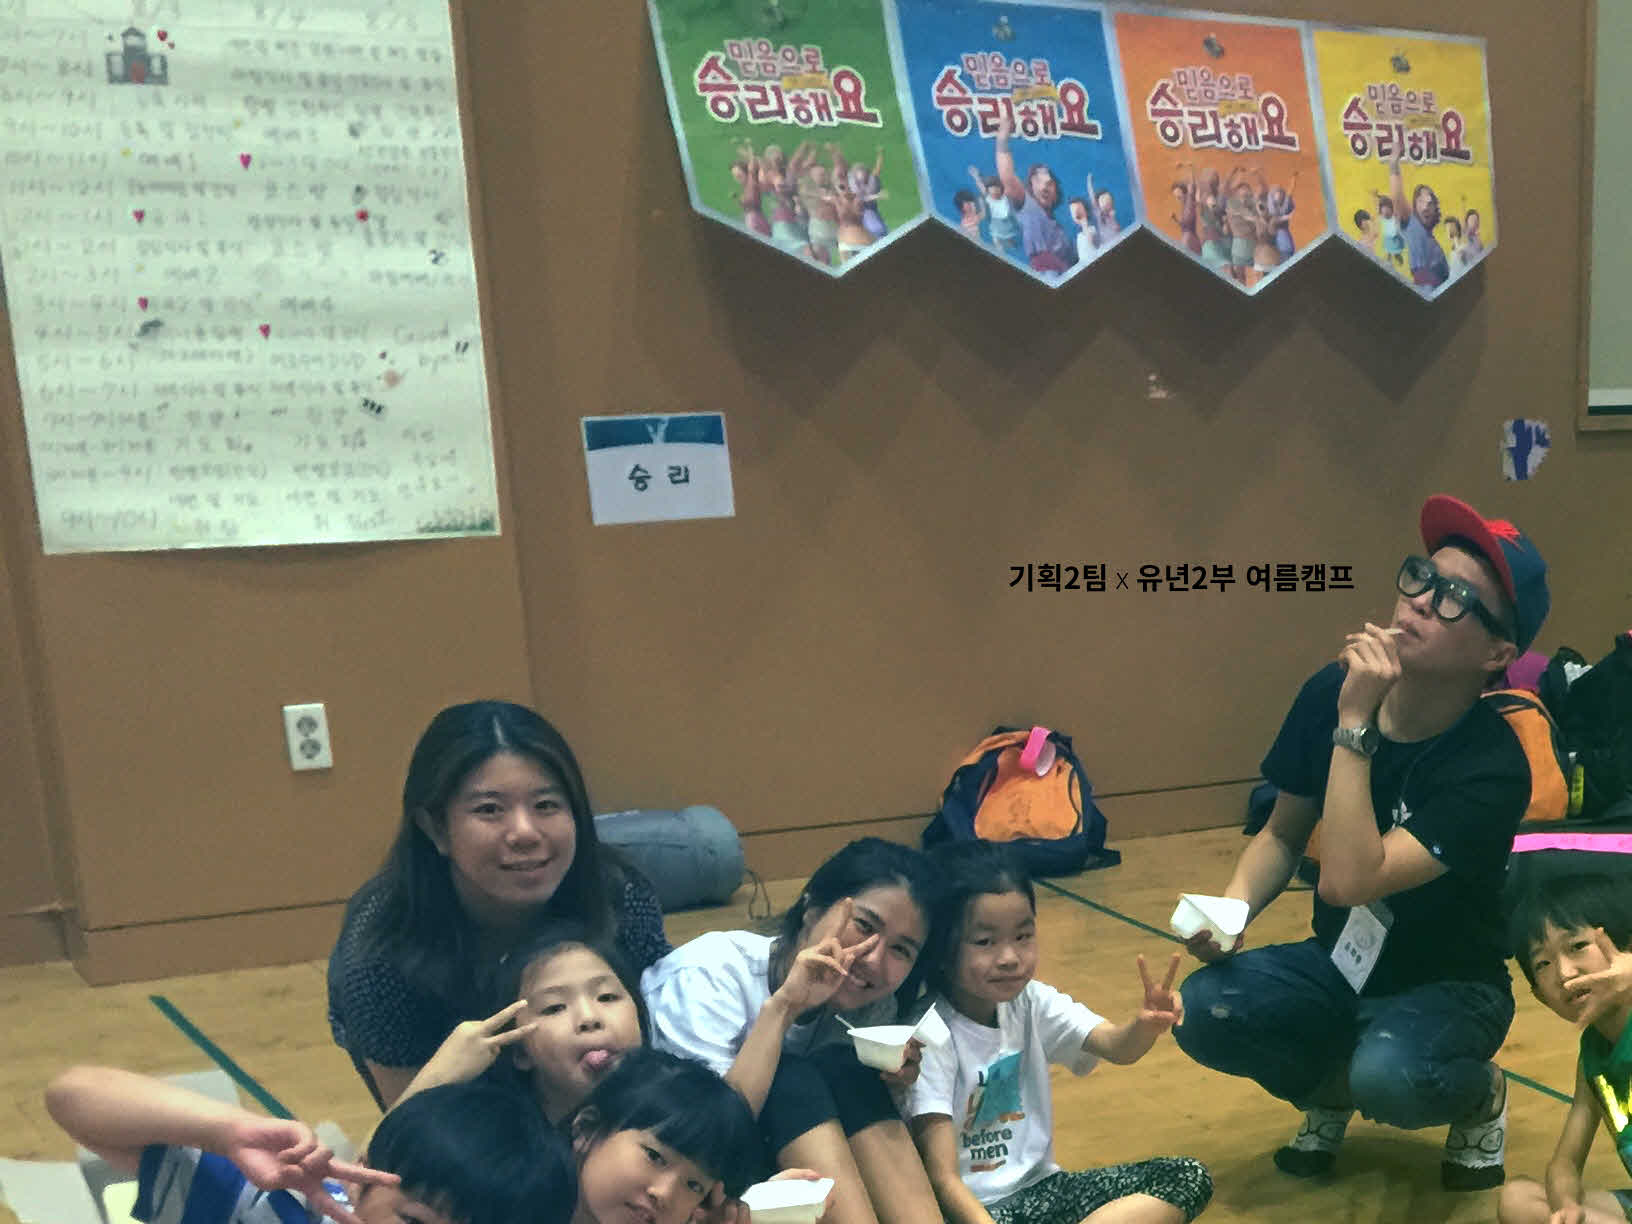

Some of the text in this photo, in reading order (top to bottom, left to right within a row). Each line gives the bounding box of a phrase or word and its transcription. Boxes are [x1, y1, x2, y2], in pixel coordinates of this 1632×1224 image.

[726, 38, 823, 72] 믿음으로
[963, 52, 1050, 88] 믿음으로
[695, 53, 881, 126] 승리해요
[1176, 67, 1254, 101] 믿음으로
[1367, 82, 1437, 116] 믿음으로
[935, 68, 1099, 137] 승리해요
[1150, 82, 1297, 149] 승리해요
[1343, 96, 1471, 161] 승리해요
[627, 463, 691, 492] 승리
[961, 1127, 1013, 1149] before
[969, 1142, 1009, 1161] men
